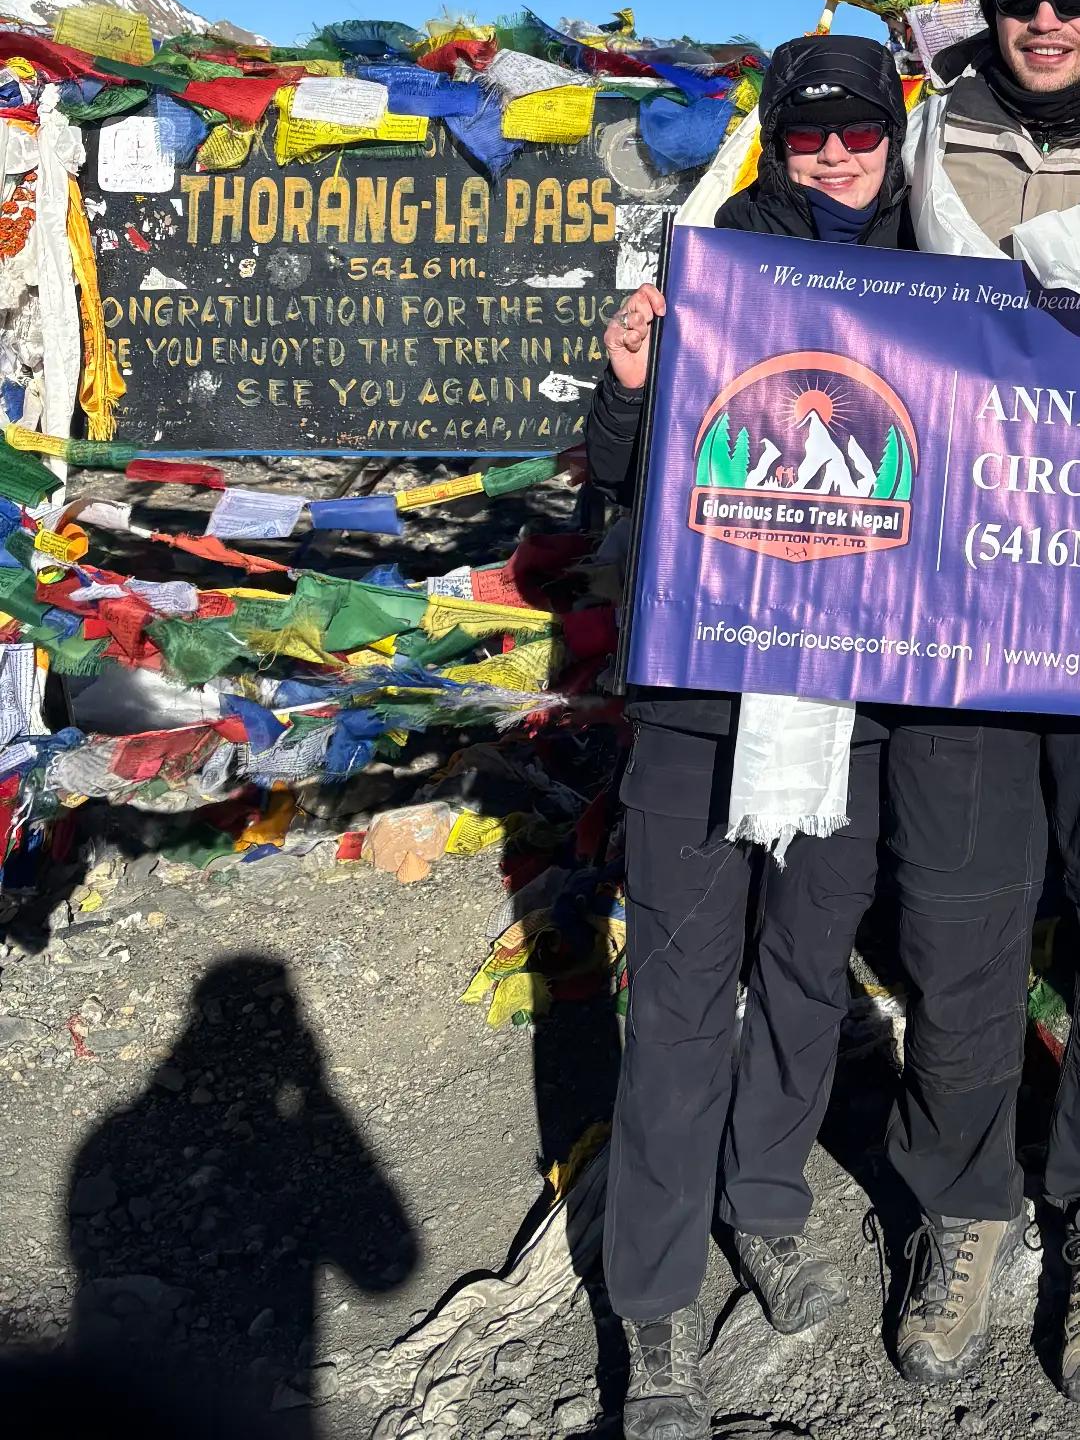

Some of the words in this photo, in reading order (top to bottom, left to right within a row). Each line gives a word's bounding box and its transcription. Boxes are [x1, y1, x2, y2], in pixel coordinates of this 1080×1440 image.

[181, 174, 490, 244] THORANG-LA
[504, 177, 617, 244] PASS
[773, 265, 803, 287] We
[806, 270, 857, 291] make
[859, 277, 905, 297] your
[908, 281, 947, 304] stay
[952, 282, 970, 302] in
[975, 284, 1031, 311] Nepal
[102, 296, 385, 330] ONGRATULATION
[401, 296, 469, 329] FOR
[476, 295, 544, 327] THE
[554, 295, 630, 327] SUC
[146, 337, 202, 367] YOU
[212, 337, 346, 367] ENJOYED
[358, 337, 420, 366] THE
[433, 337, 511, 368] TREK
[521, 337, 552, 365] IN
[562, 336, 609, 366] MA
[236, 378, 314, 407] SEE
[328, 377, 406, 407] YOU
[418, 377, 532, 407] AGAIN
[702, 499, 773, 522] Glorious
[776, 505, 805, 524] Eco
[809, 506, 848, 527] Trek
[851, 509, 899, 535] Nepal
[734, 530, 811, 544] EXPEDITION
[696, 621, 973, 661] info@gloriousecotrek.com
